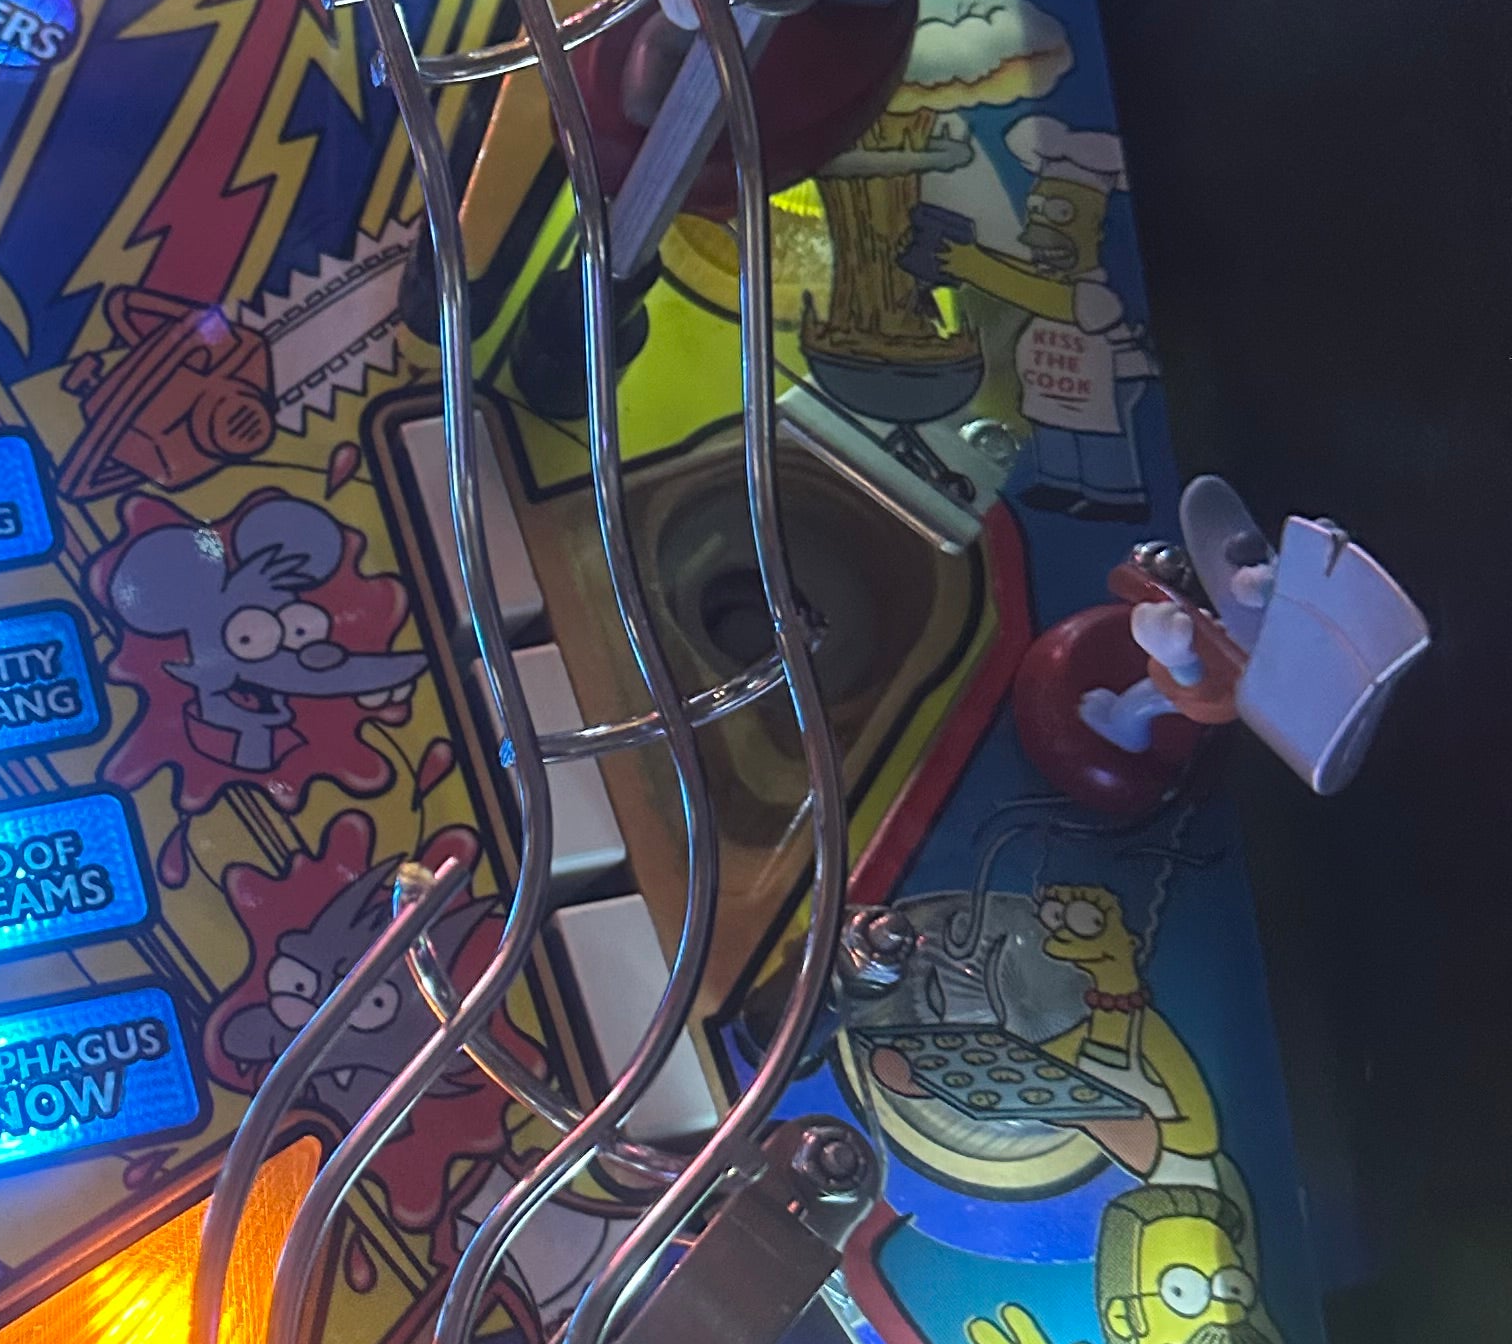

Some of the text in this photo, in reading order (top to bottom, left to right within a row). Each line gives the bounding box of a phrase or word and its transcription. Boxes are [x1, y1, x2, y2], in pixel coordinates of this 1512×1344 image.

[1032, 329, 1084, 353] KISS
[1033, 349, 1080, 373] THE
[1022, 369, 1091, 394] COOK
[22, 835, 76, 871] OF
